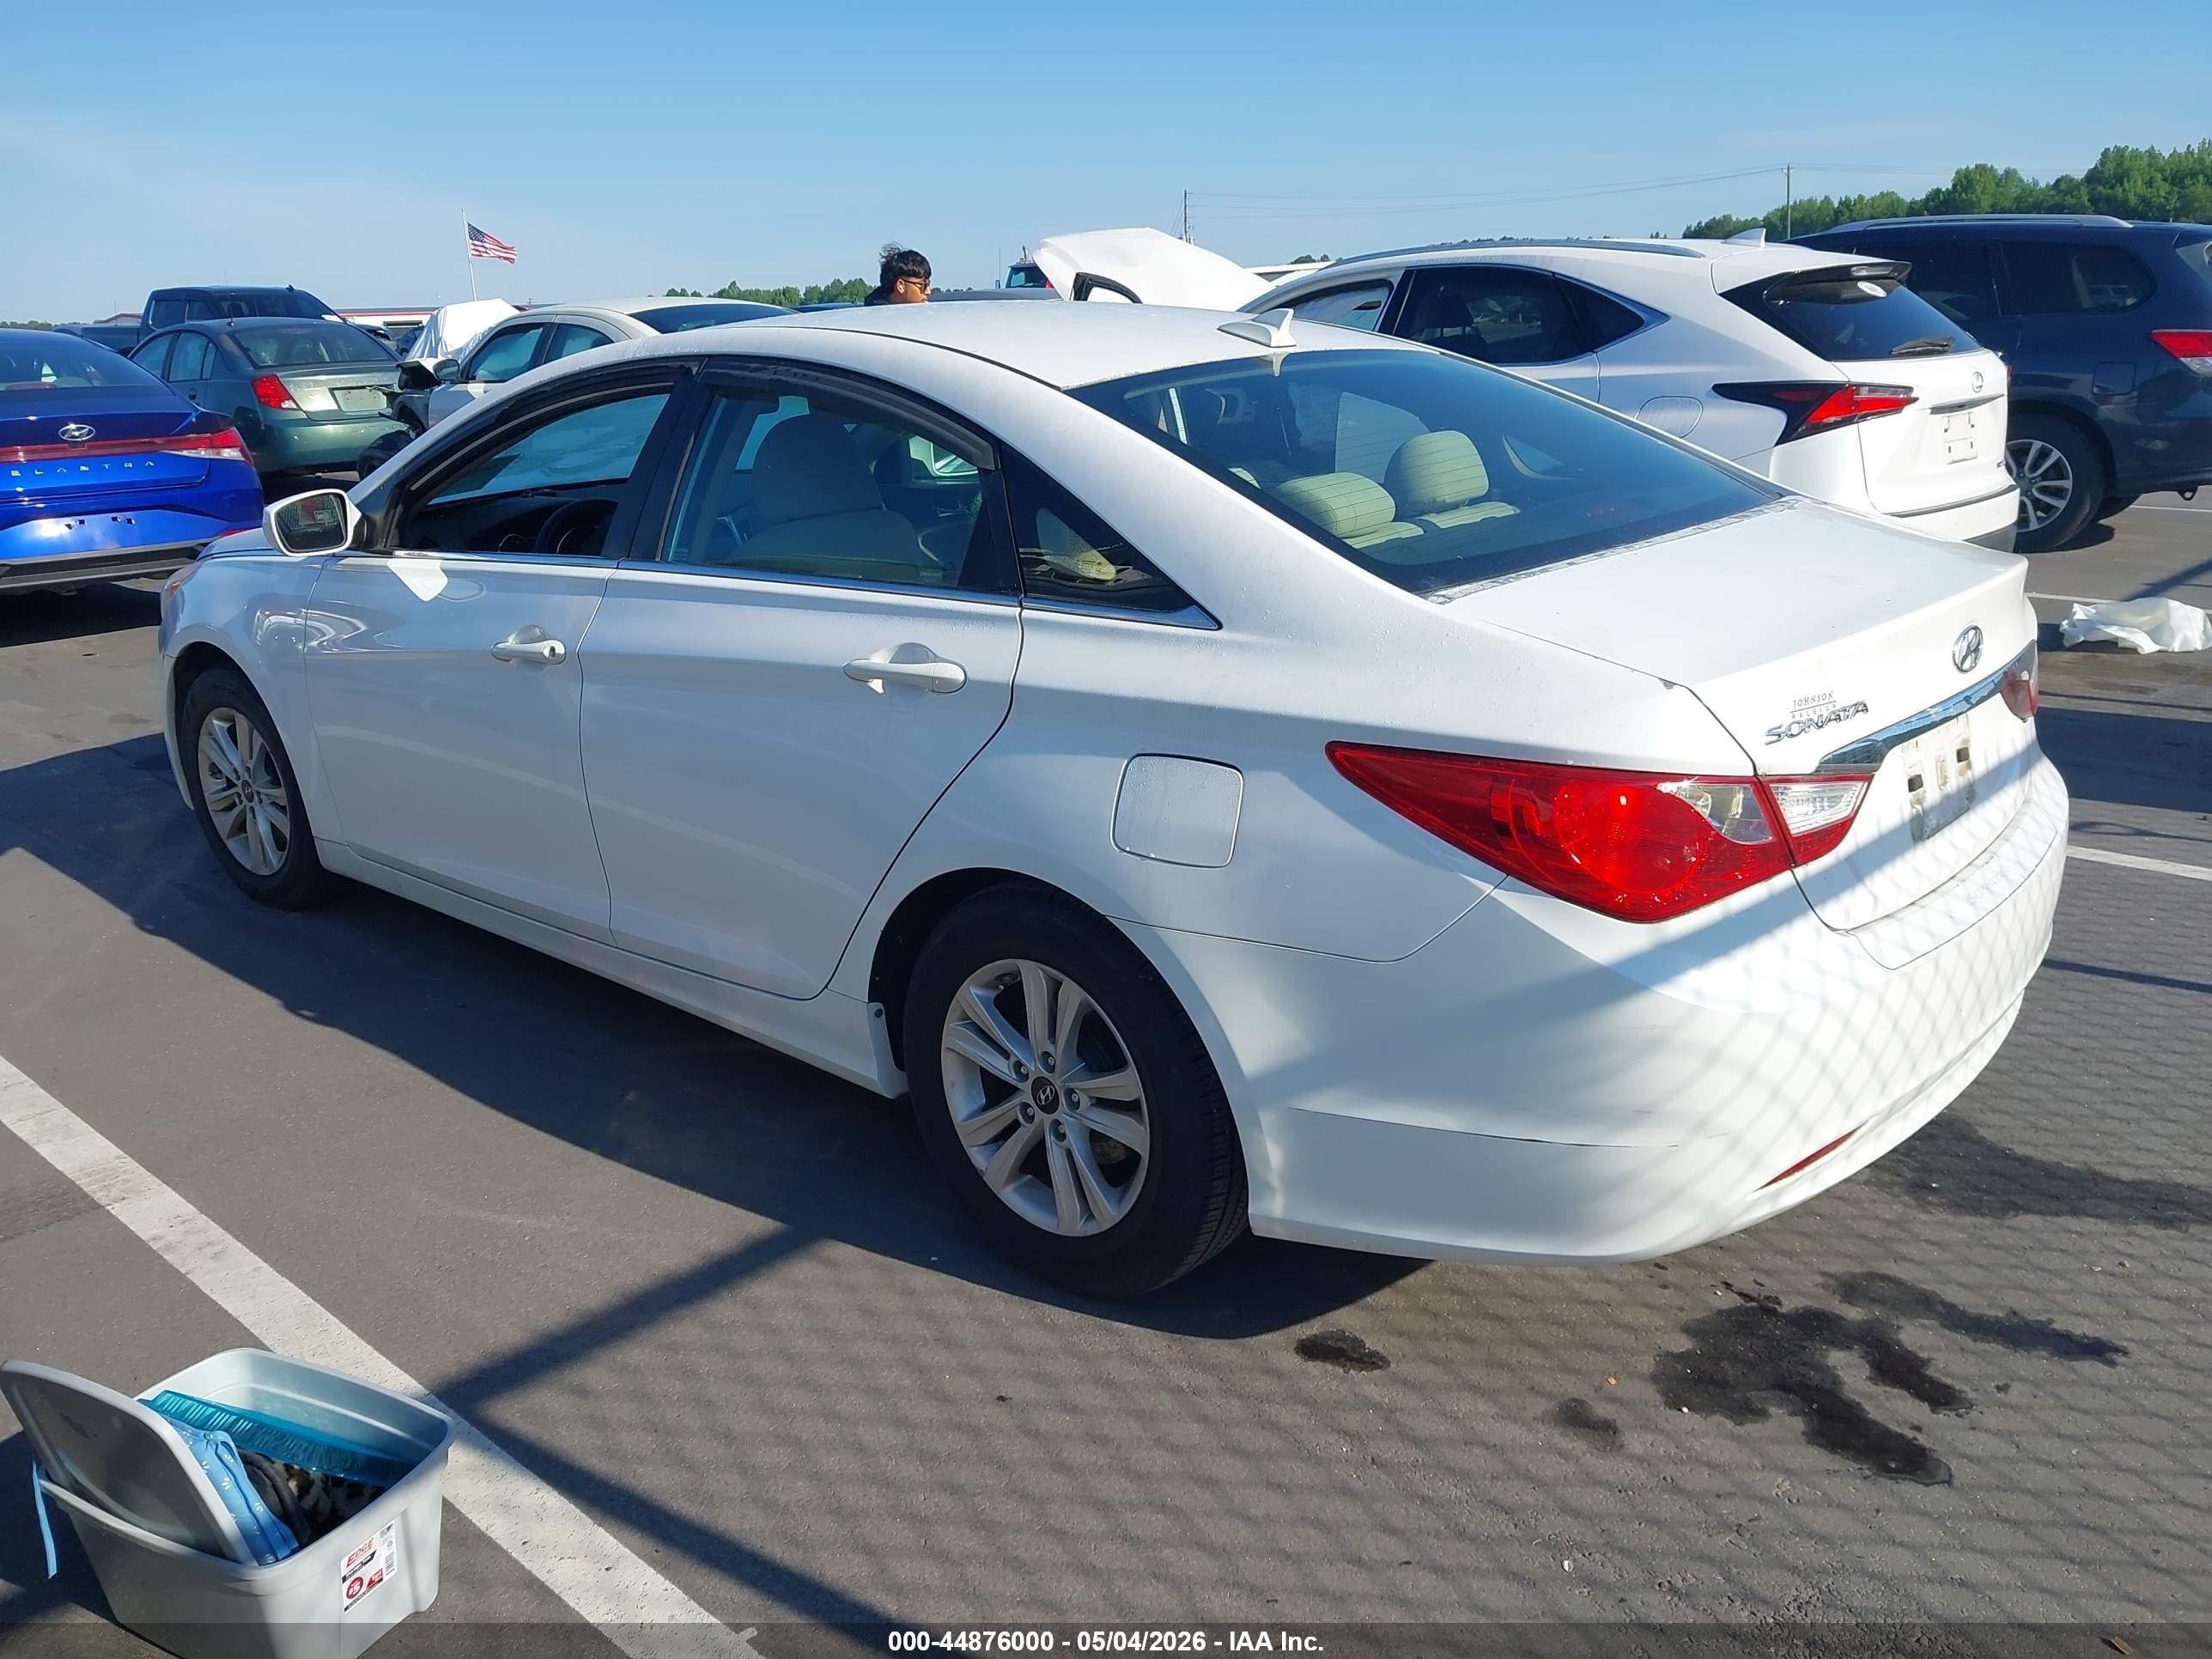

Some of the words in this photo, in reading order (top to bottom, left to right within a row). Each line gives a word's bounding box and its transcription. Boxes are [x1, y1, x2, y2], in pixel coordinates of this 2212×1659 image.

[1793, 690, 1834, 709] JOHNSON
[1765, 700, 1869, 745] SONATA
[346, 1537, 374, 1568] EDGE
